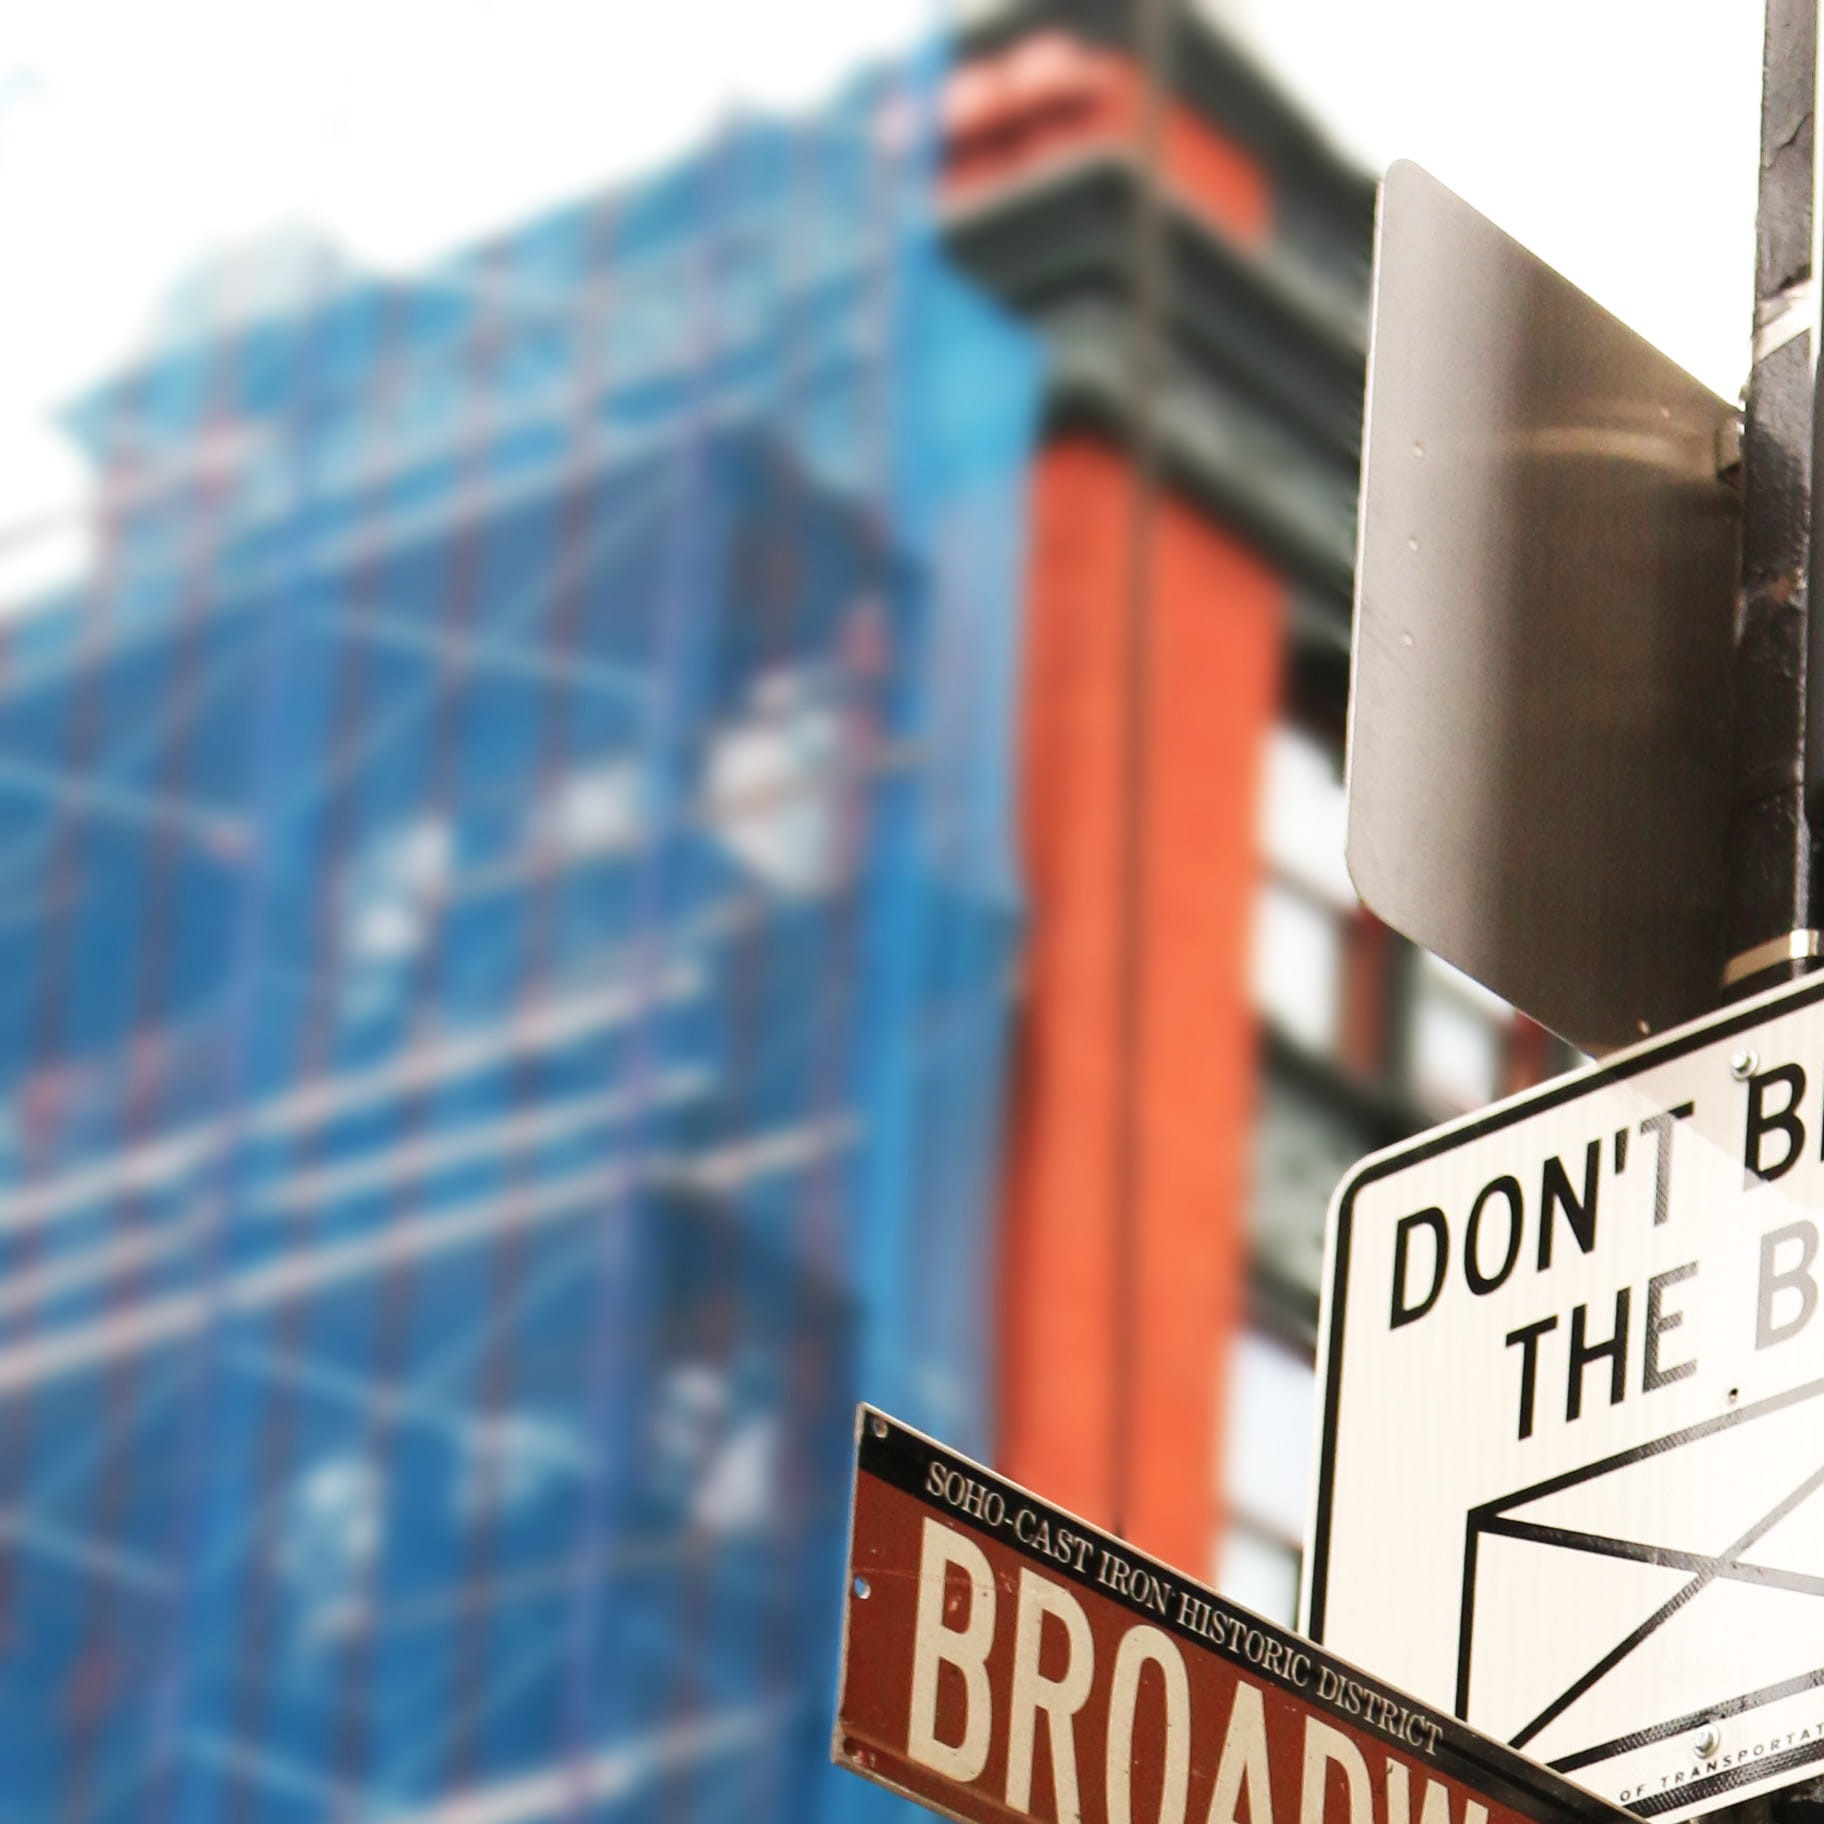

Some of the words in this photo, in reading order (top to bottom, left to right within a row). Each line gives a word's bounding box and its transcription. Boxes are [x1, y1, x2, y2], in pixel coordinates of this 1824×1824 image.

[1389, 1102, 1693, 1330] DON'T
[1504, 1261, 1699, 1440] THE
[925, 1461, 1094, 1574] SOHO-CAST
[1098, 1550, 1172, 1612] IRON
[1176, 1593, 1311, 1687] HISTORIC
[1316, 1665, 1444, 1756] DISTRICT
[1619, 1786, 1645, 1803] OF
